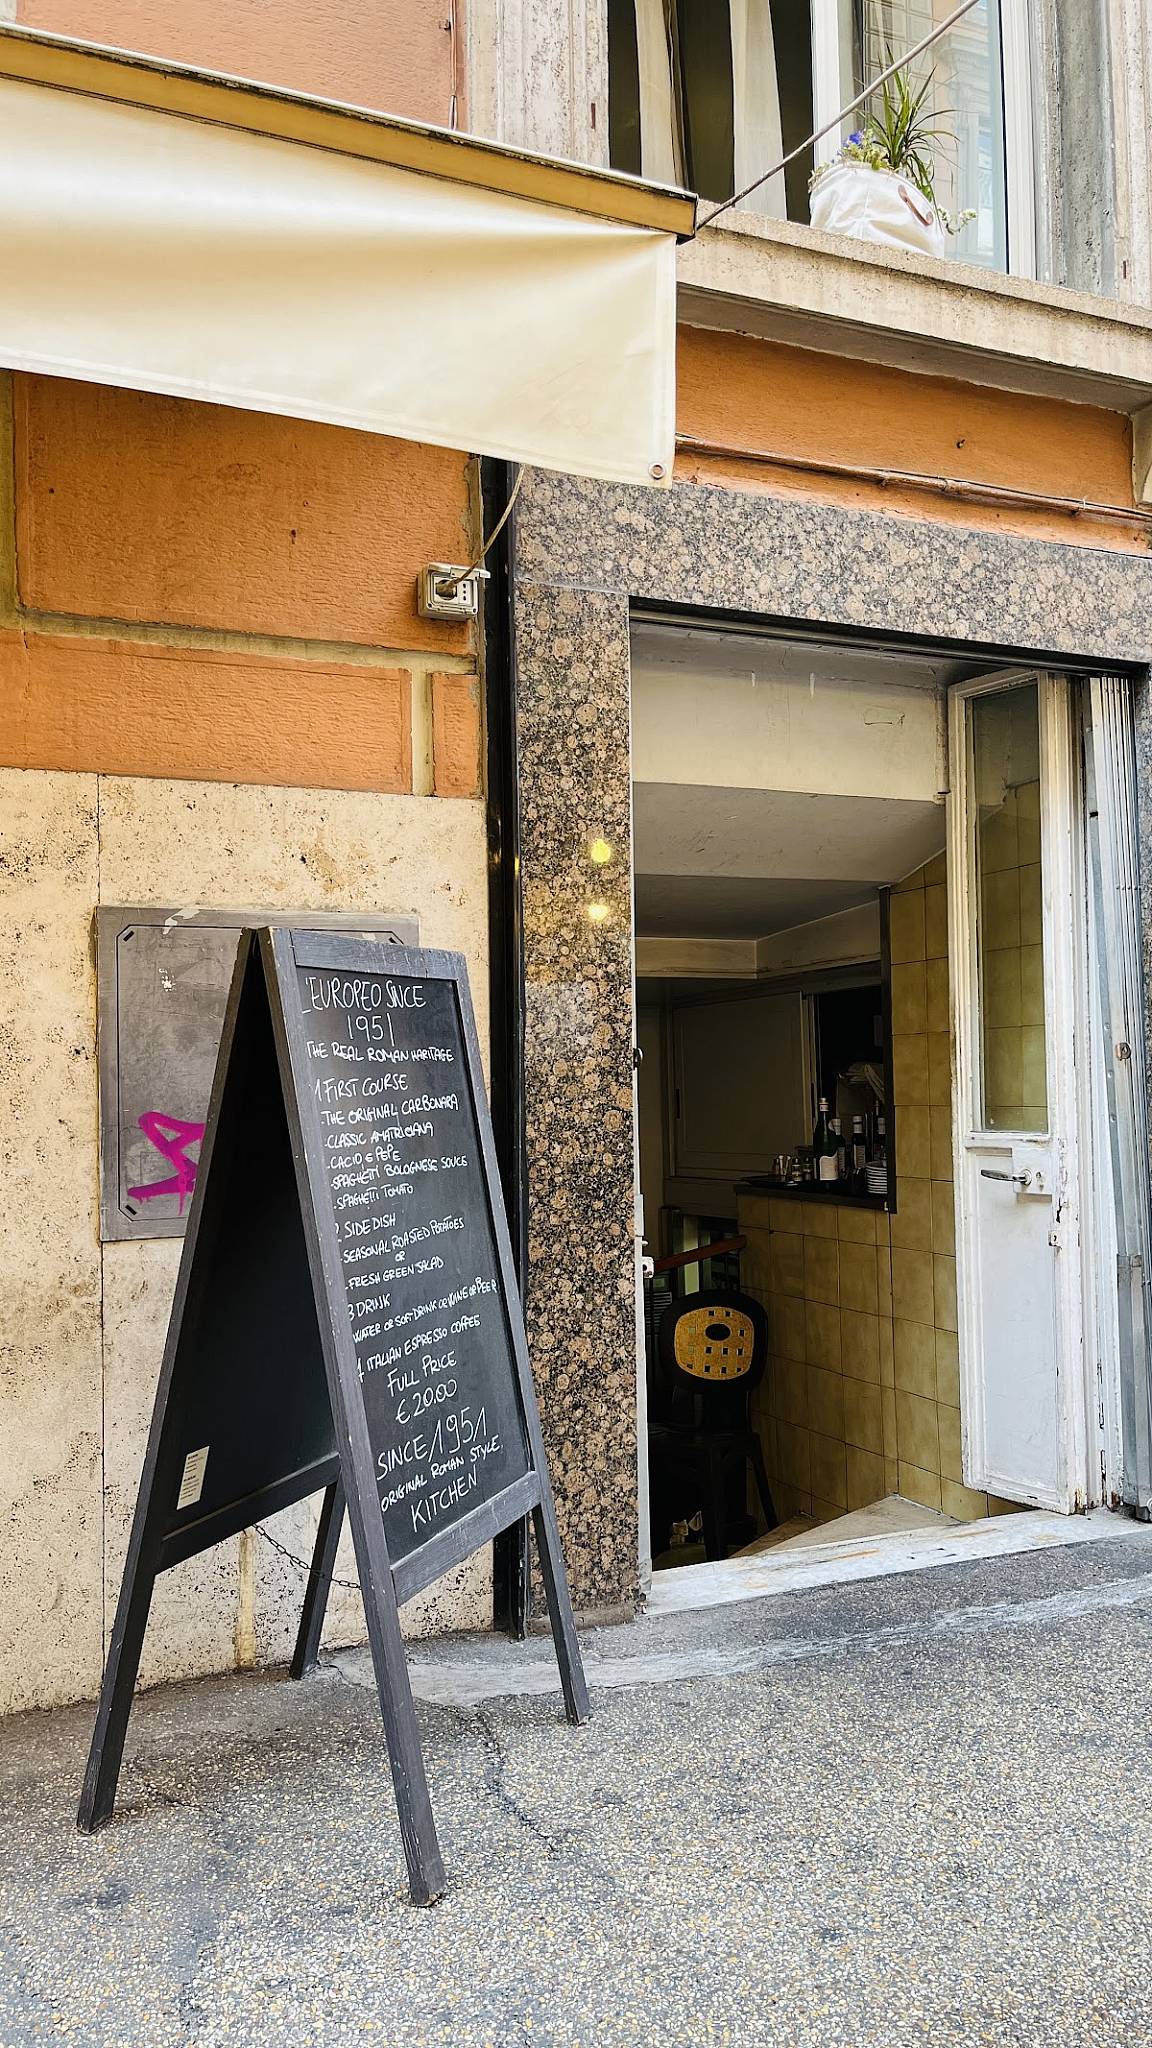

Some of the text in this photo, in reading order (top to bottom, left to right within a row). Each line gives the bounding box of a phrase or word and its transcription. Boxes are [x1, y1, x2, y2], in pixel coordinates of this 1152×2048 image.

[385, 979, 427, 1008] SINCE
[347, 1013, 395, 1047] 1951
[306, 1041, 329, 1059] THE
[331, 1042, 364, 1061] REAL
[367, 1047, 409, 1064] ROMAN
[314, 1073, 409, 1103] 1 FIRST COURSE
[348, 1103, 399, 1125] ORIGINAL
[401, 1093, 460, 1116] CARBONARA
[375, 1143, 402, 1163] PEPE
[384, 1157, 439, 1177] BOLOGNESE
[440, 1155, 468, 1169] SOUCE
[380, 1182, 414, 1199] TOMATO
[344, 1218, 371, 1239] SIDE
[371, 1212, 397, 1231] DISH
[391, 1226, 431, 1250] ROASTED
[429, 1214, 465, 1236] POTATOES
[382, 1265, 416, 1282] GREEN
[415, 1255, 445, 1273] SALAD
[394, 1251, 407, 1263] OR
[353, 1324, 382, 1344] WATER
[383, 1319, 395, 1332] OR
[395, 1312, 414, 1328] SOFT
[412, 1300, 438, 1321] DRINK
[438, 1297, 449, 1309] OR
[447, 1286, 470, 1308] WINE
[355, 1293, 393, 1317] DRINK
[366, 1346, 402, 1372] ITALIAN
[404, 1327, 449, 1356] ESPRESSO
[450, 1314, 482, 1334] COFFEE
[387, 1350, 457, 1397] FULL PRICE
[376, 1406, 488, 1480] SINCE 1951
[380, 1473, 429, 1513] ORIGINAL
[430, 1455, 465, 1480] ROMAN
[410, 1464, 479, 1532] KITCHEN
